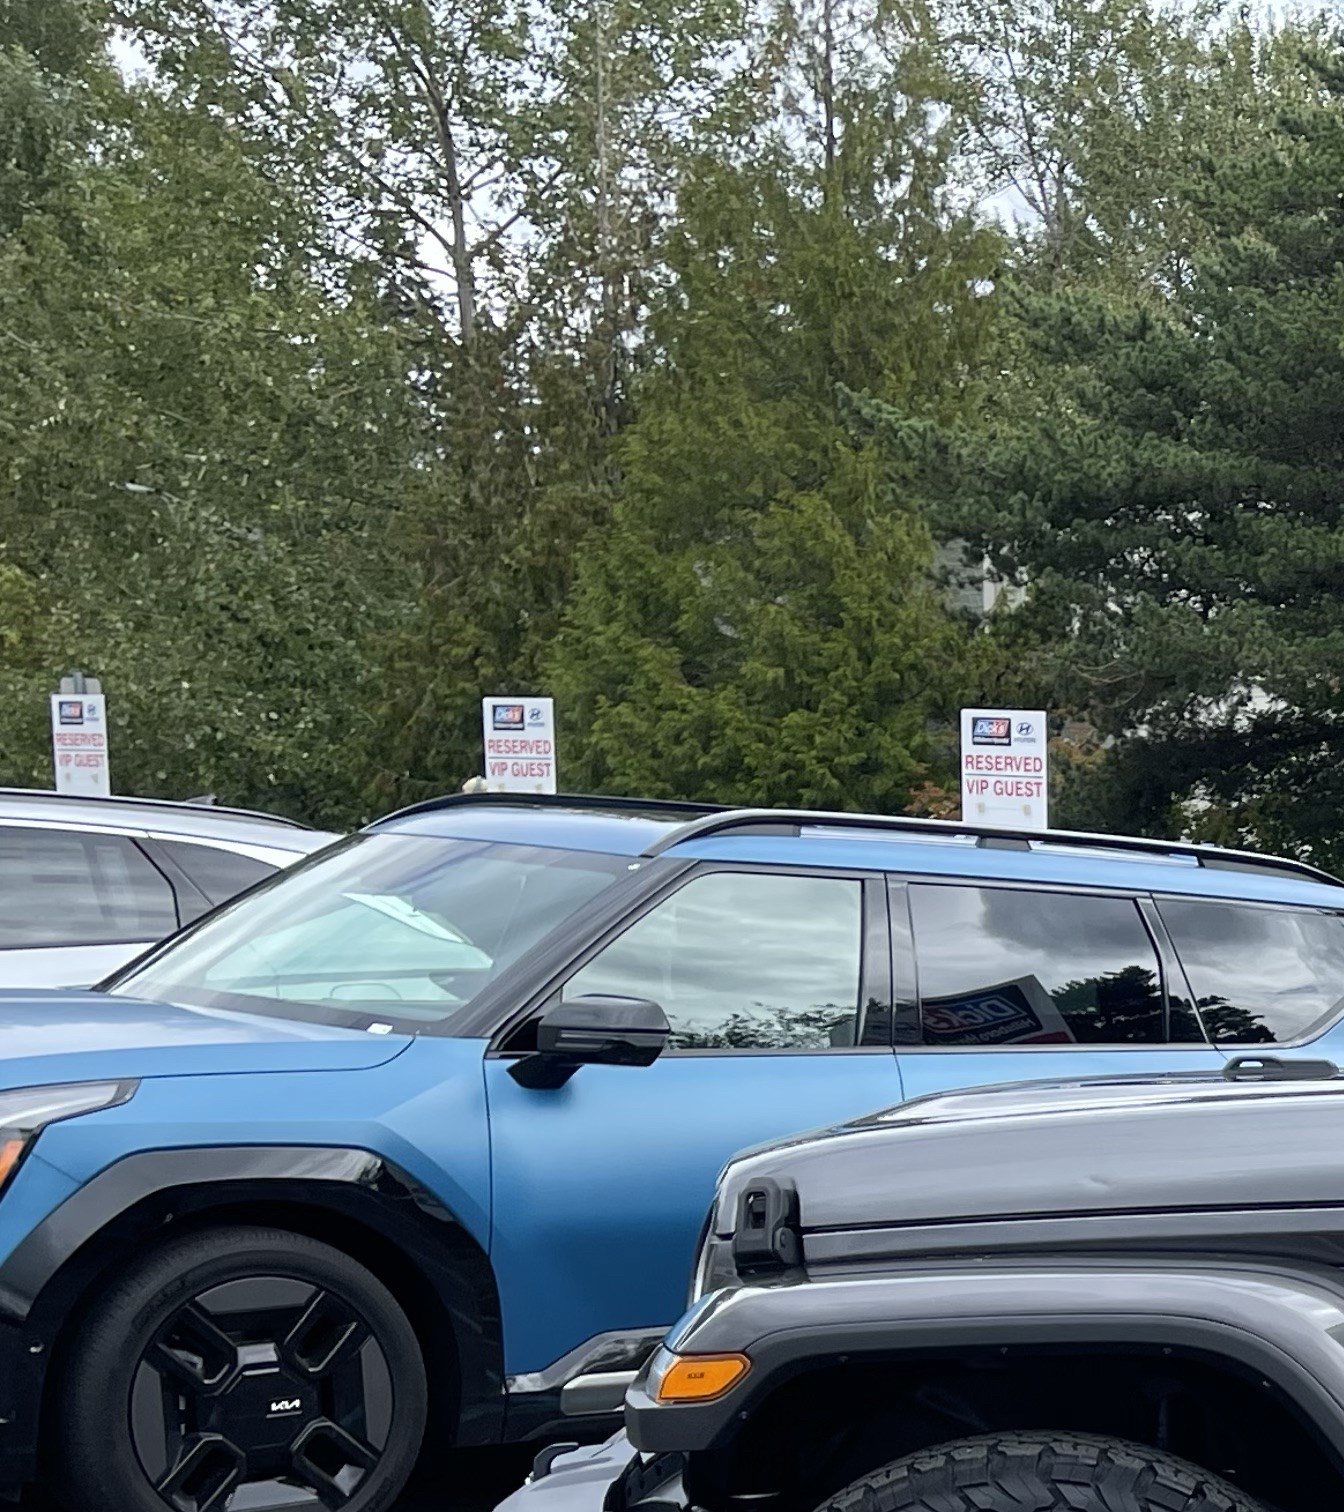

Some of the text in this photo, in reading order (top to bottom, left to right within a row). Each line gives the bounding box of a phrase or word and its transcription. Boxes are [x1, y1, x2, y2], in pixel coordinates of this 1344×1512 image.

[965, 755, 1043, 773] RESERVED
[966, 779, 1043, 798] VIP GUEST
